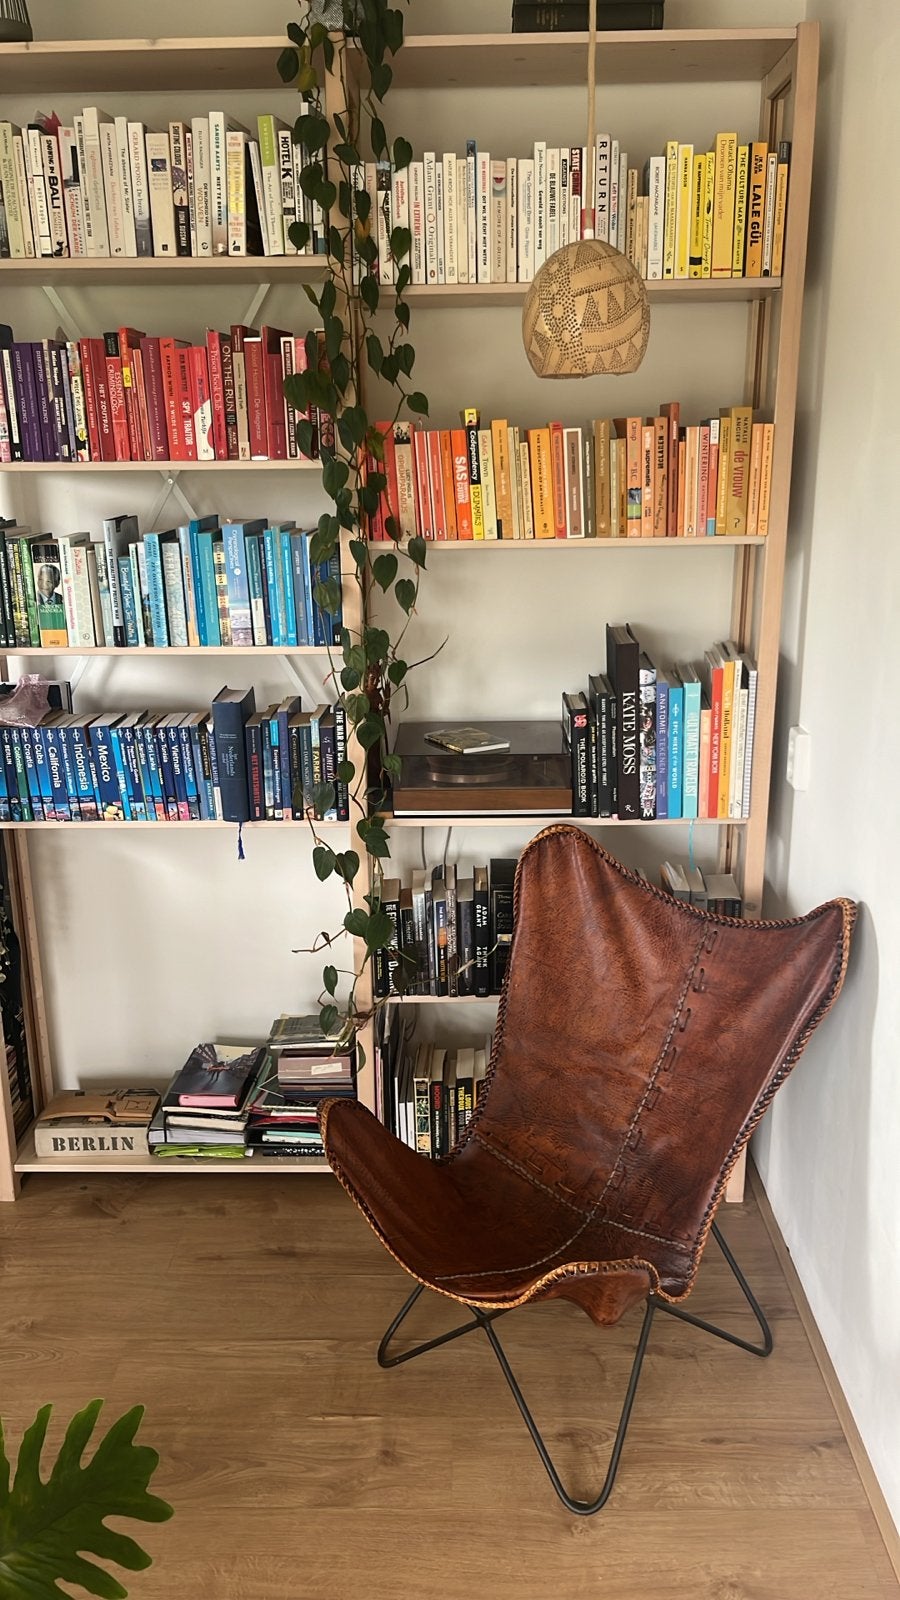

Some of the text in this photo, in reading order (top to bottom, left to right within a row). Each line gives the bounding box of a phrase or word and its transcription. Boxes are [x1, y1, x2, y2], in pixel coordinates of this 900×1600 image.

[282, 136, 290, 164] HOTEL
[572, 150, 580, 172] STATE
[282, 167, 292, 180] K
[598, 140, 608, 212] RETURN
[738, 170, 746, 204] CULTURE
[48, 176, 61, 208] BALI
[750, 184, 762, 247] LALE GÜL
[427, 226, 436, 264] Originals
[222, 346, 235, 412] ON THE RUN
[455, 456, 467, 480] SAS
[470, 430, 478, 480] Codependency
[732, 450, 748, 498] de vrouw
[336, 710, 344, 724] THE
[337, 742, 344, 751] ON
[622, 691, 636, 775] KATE MOSS
[4, 744, 12, 765] BERLIN
[24, 744, 34, 768] Croatia
[34, 744, 44, 764] Cuba
[48, 746, 62, 788] California
[74, 744, 90, 790] Indonesia
[97, 744, 111, 782] Mexico
[170, 745, 180, 775] Vietnam
[90, 762, 98, 788] ISTANBUL
[51, 1136, 135, 1152] BERLIN
